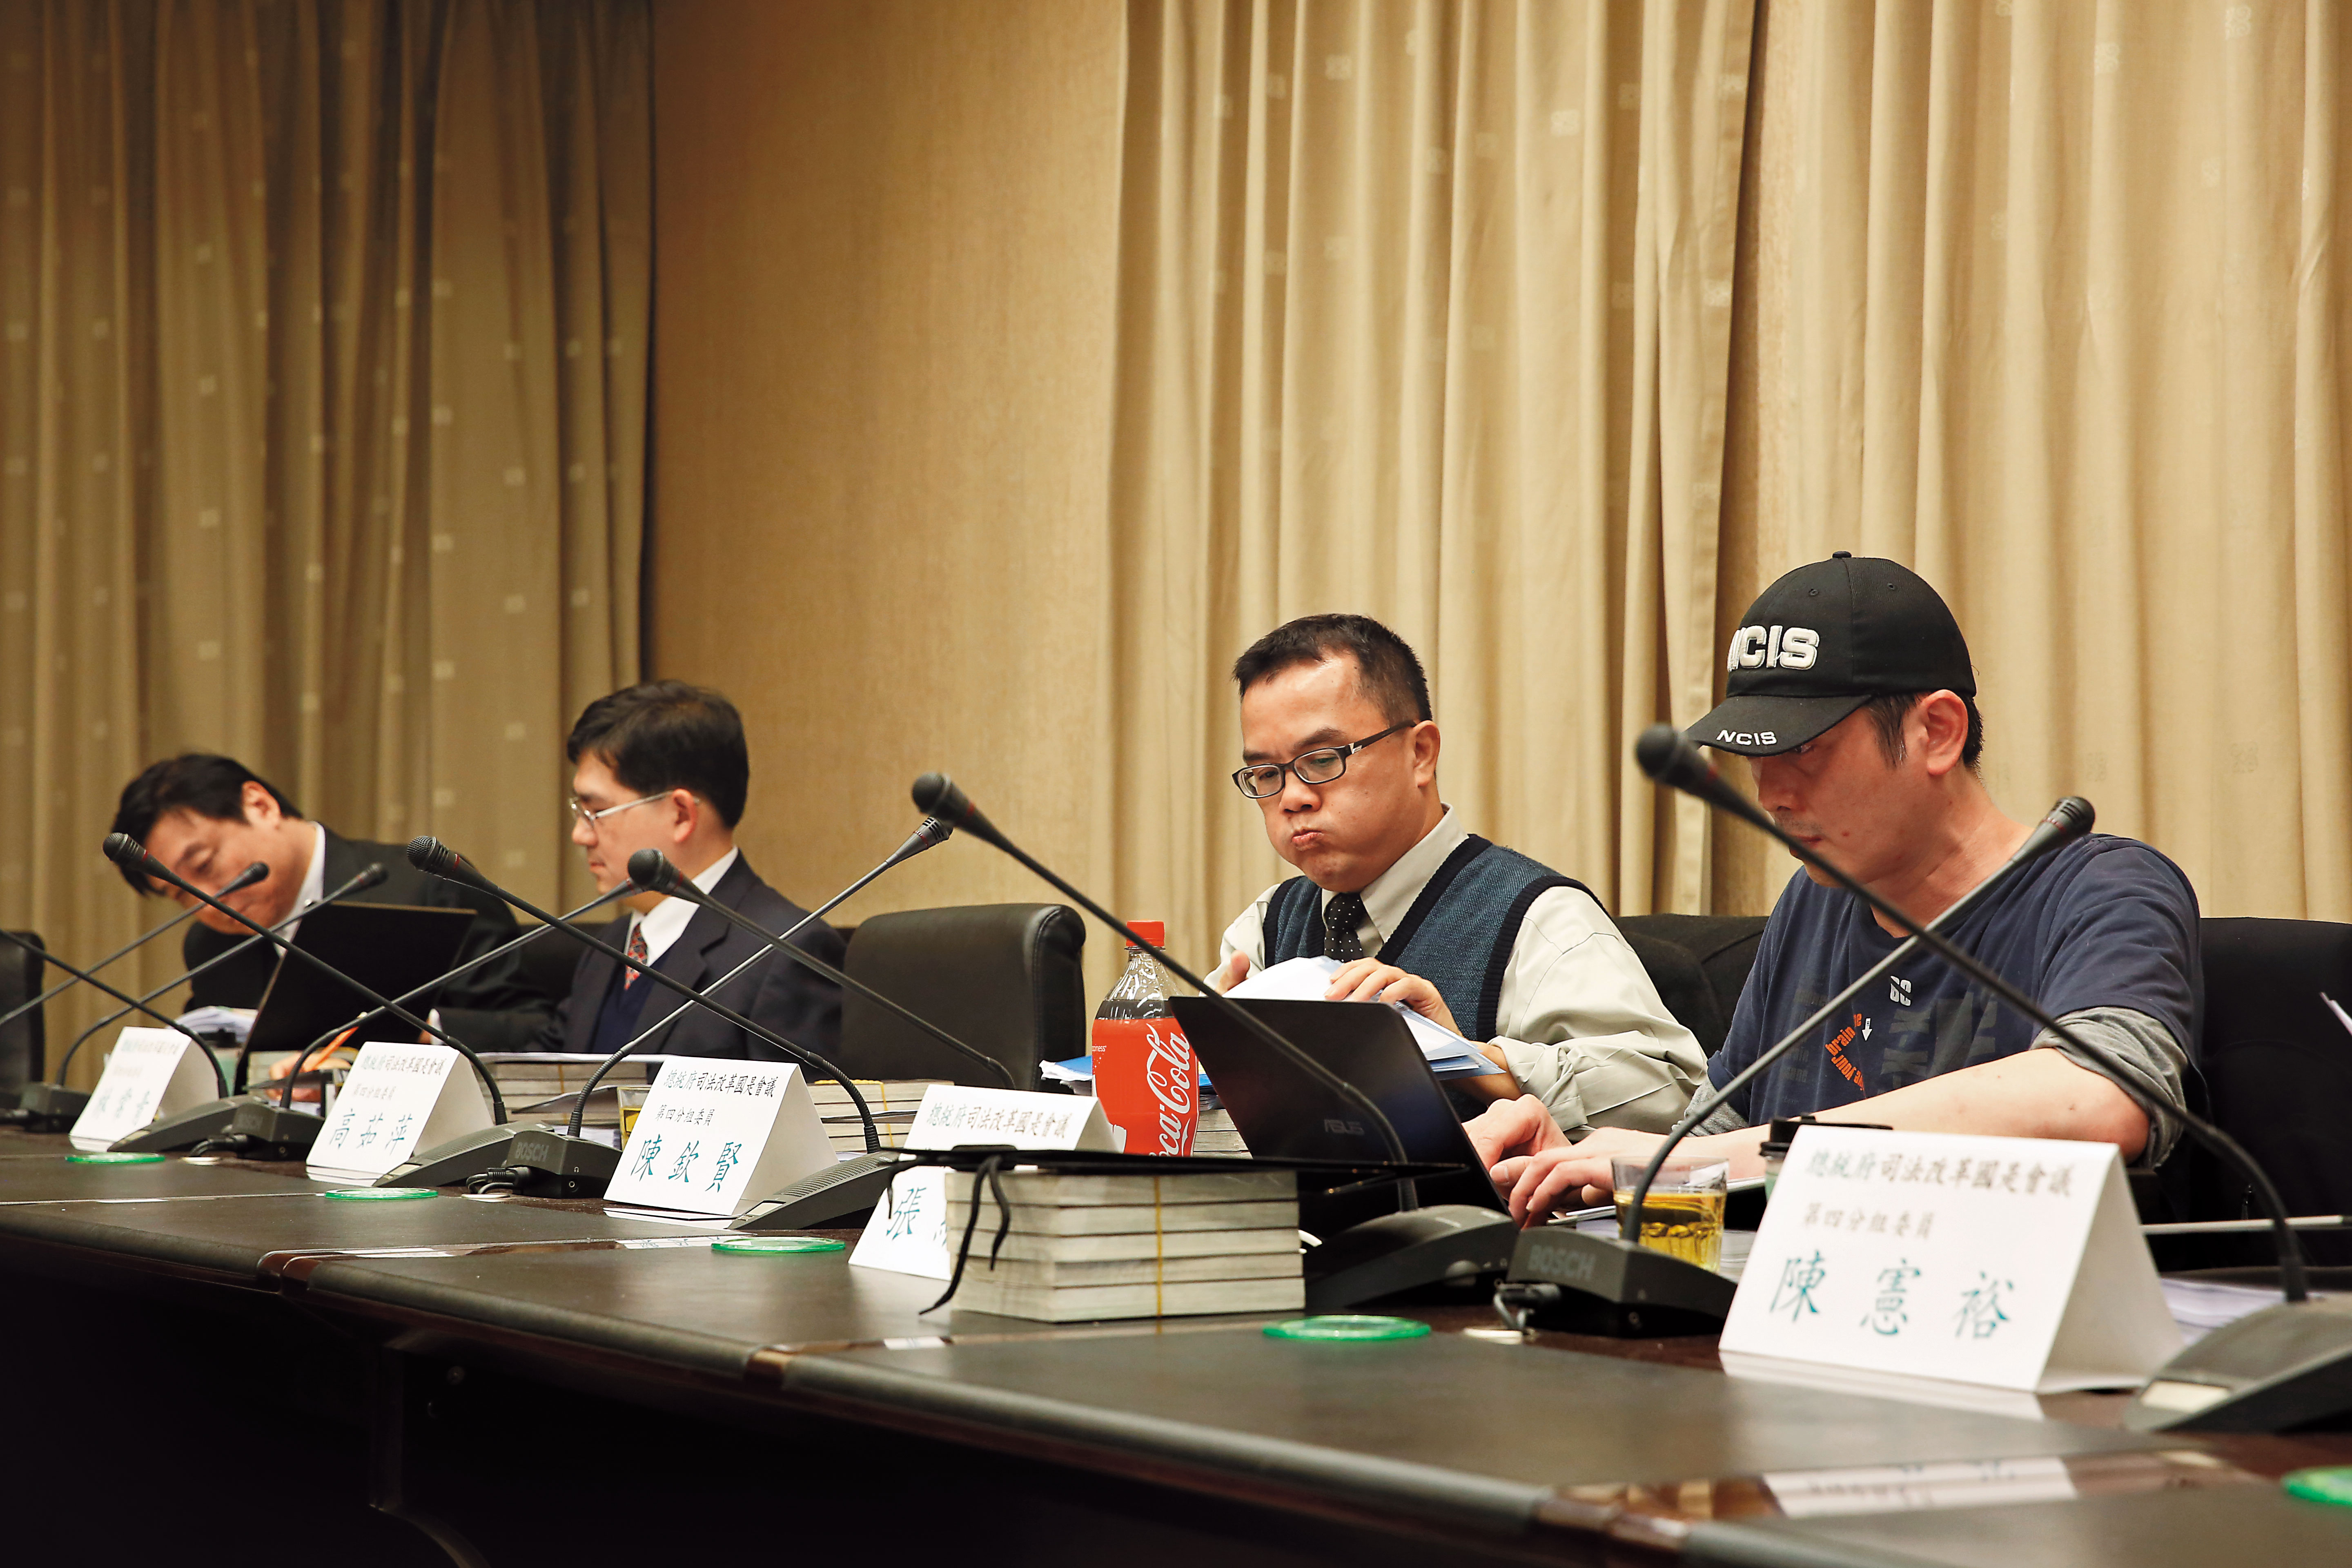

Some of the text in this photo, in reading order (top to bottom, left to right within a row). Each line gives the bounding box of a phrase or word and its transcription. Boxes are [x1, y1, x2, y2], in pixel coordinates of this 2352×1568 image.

[1716, 730, 1777, 746] NCIS
[1825, 1027, 1856, 1056] brain
[1831, 1055, 1857, 1080] your
[663, 1069, 778, 1098] 總統府司法改革國是會議
[655, 1104, 715, 1126] 第四分組委員
[1324, 1118, 1365, 1136] ASUS
[515, 1142, 550, 1162] BOSCH
[630, 1134, 742, 1192] 陳欽賢
[1769, 1250, 2015, 1341] 陳憲裕
